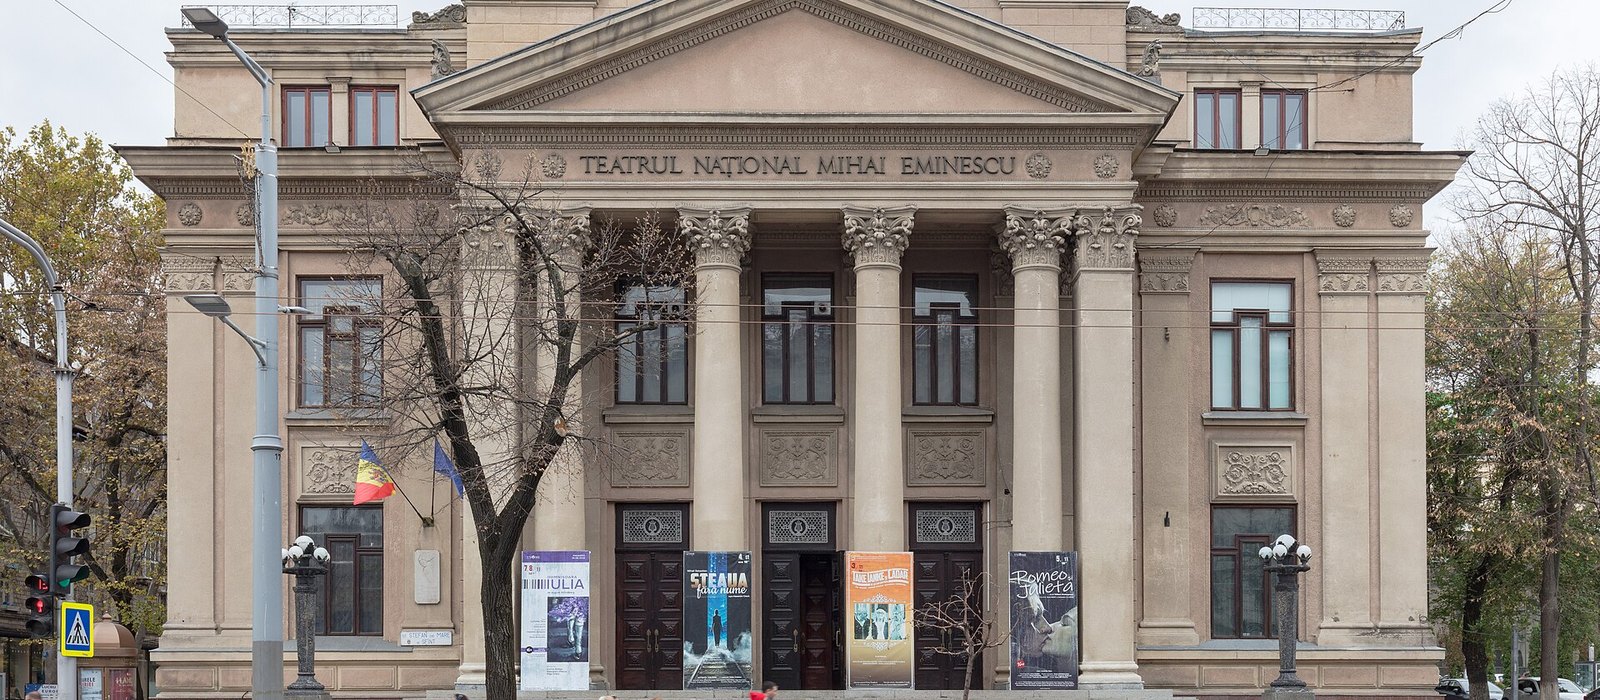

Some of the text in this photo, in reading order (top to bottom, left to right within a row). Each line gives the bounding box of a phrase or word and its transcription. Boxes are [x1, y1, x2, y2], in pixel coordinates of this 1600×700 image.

[580, 156, 1016, 178] TEATRUL NAȚIONAL MIHAI EMINESCU
[690, 572, 748, 589] STEAUA
